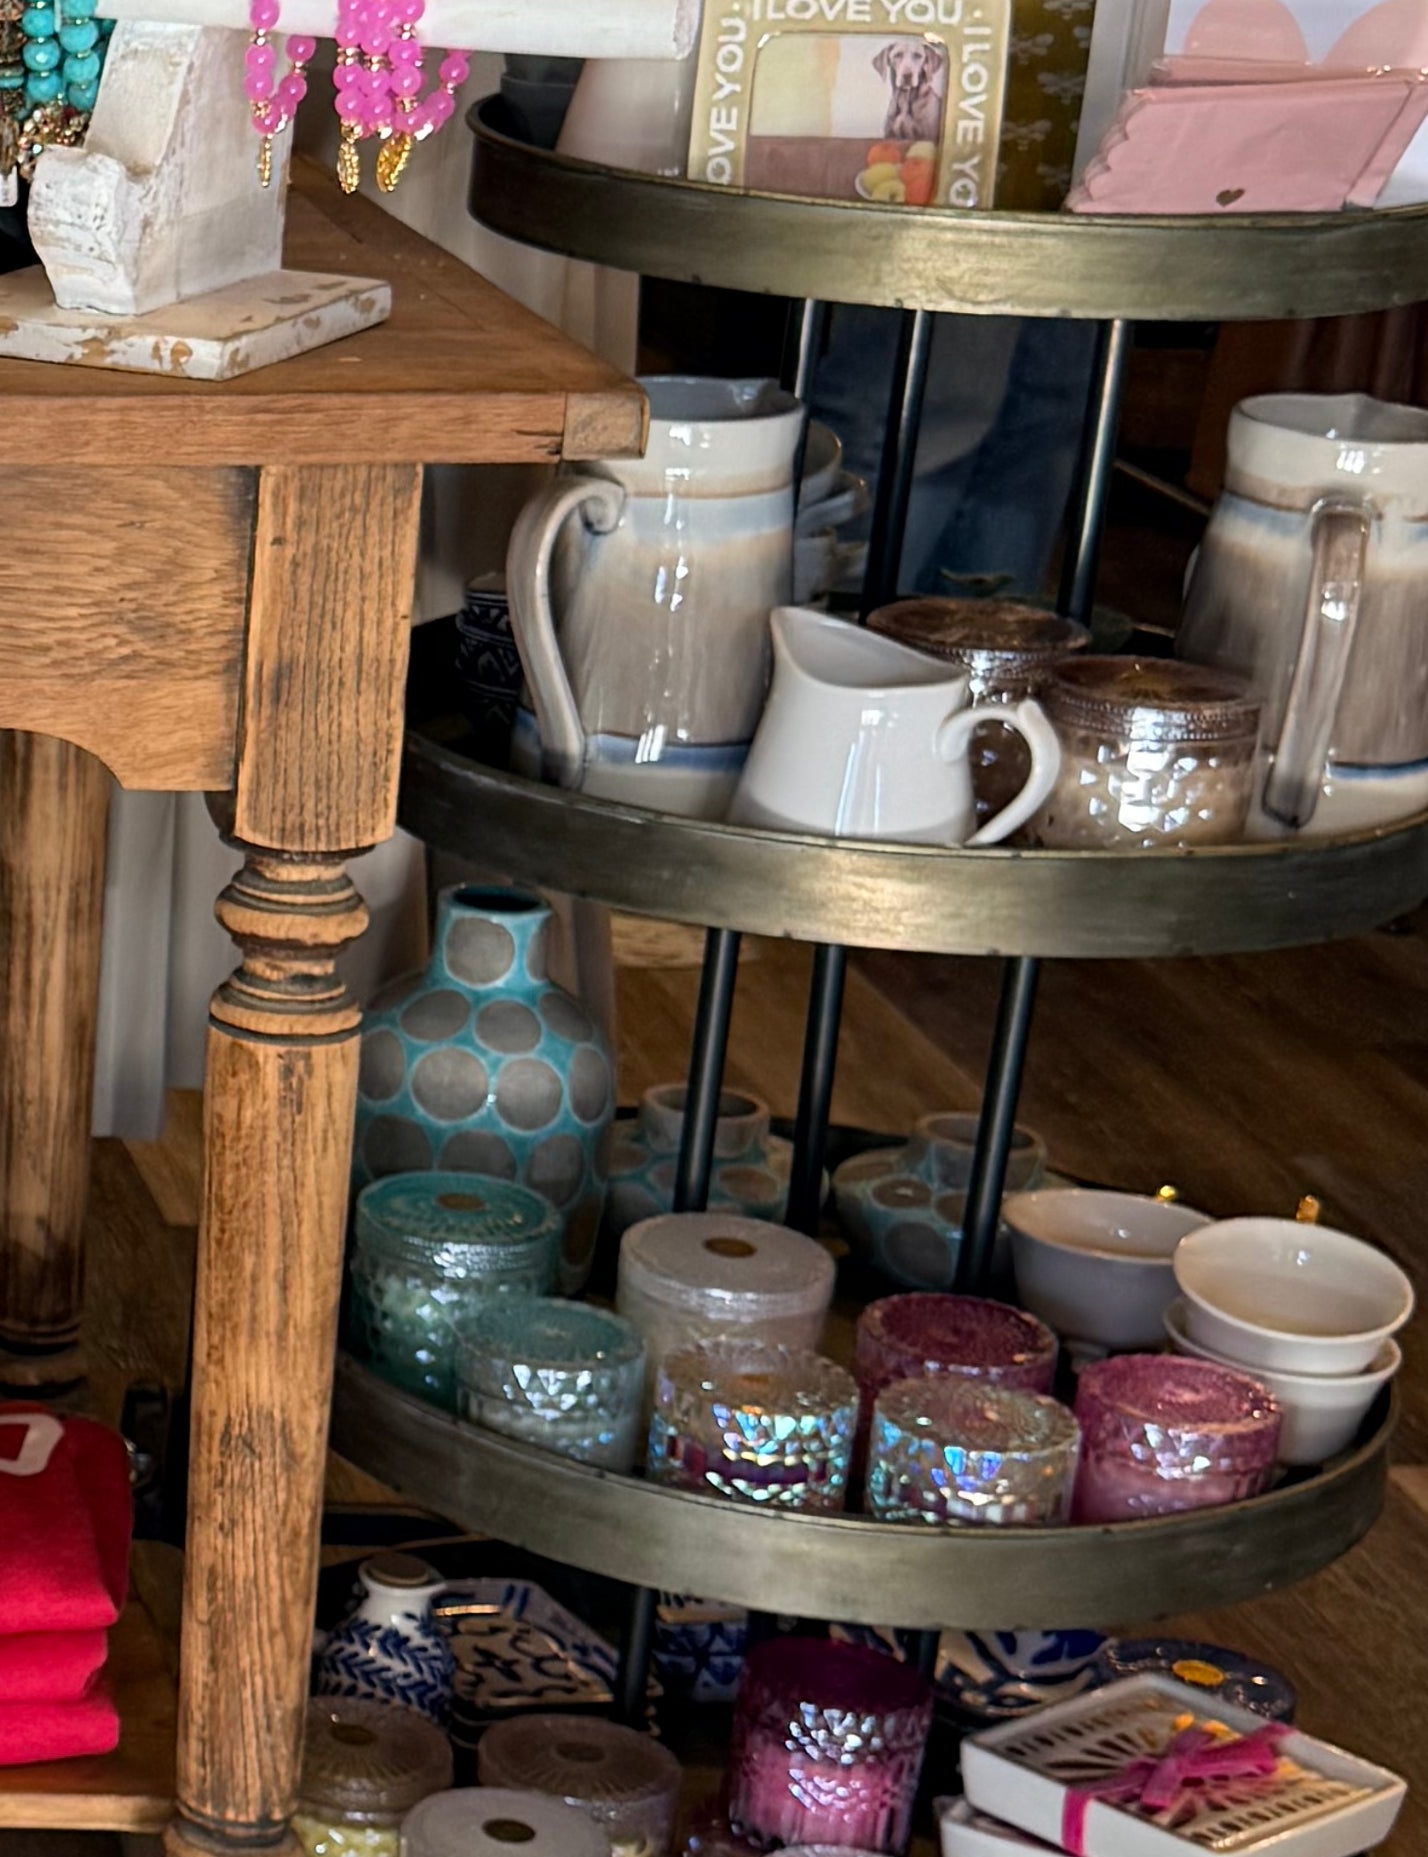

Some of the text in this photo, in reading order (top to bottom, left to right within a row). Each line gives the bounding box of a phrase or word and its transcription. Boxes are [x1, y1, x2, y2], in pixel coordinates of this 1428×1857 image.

[706, 17, 746, 185] OVE YOU
[949, 25, 992, 208] I LOVE YO
